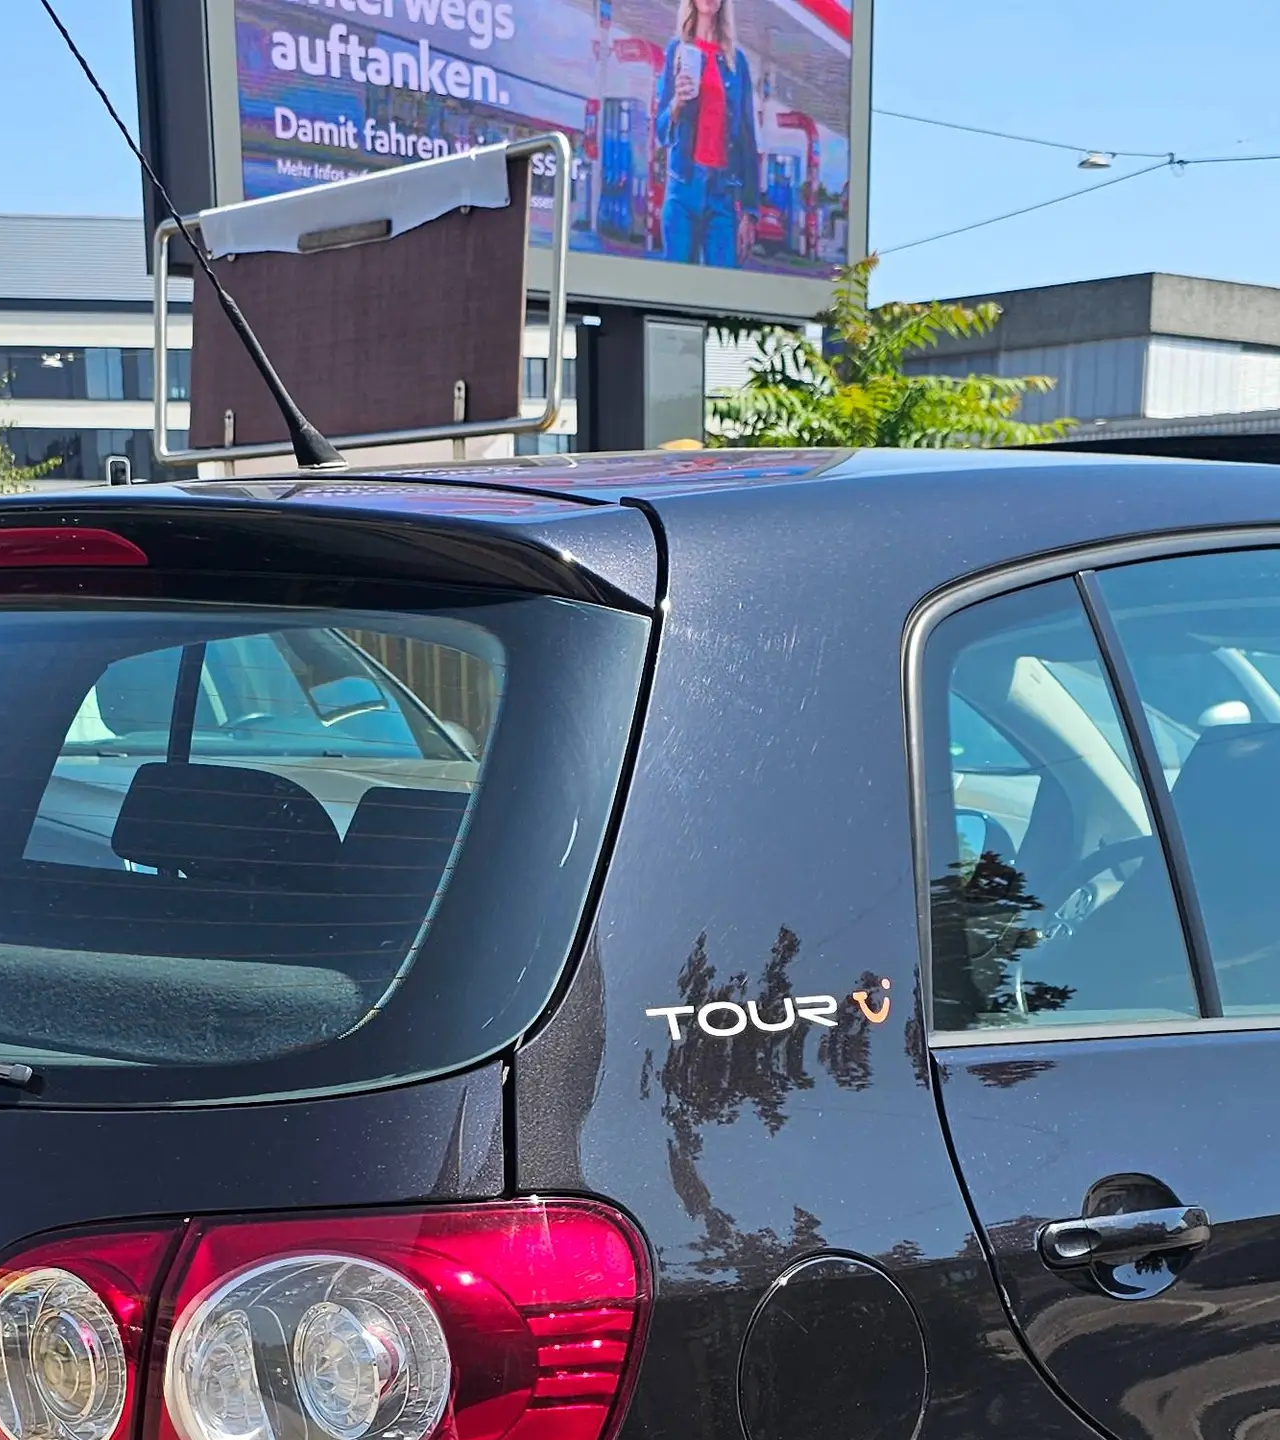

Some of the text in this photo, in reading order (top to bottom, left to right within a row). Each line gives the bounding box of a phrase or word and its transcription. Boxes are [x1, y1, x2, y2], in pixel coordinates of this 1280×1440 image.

[271, 22, 510, 105] auftanken.
[274, 105, 449, 160] Damit fahren
[276, 157, 312, 177] Mehr
[314, 163, 346, 181] Infos
[645, 994, 839, 1041] TOUR
